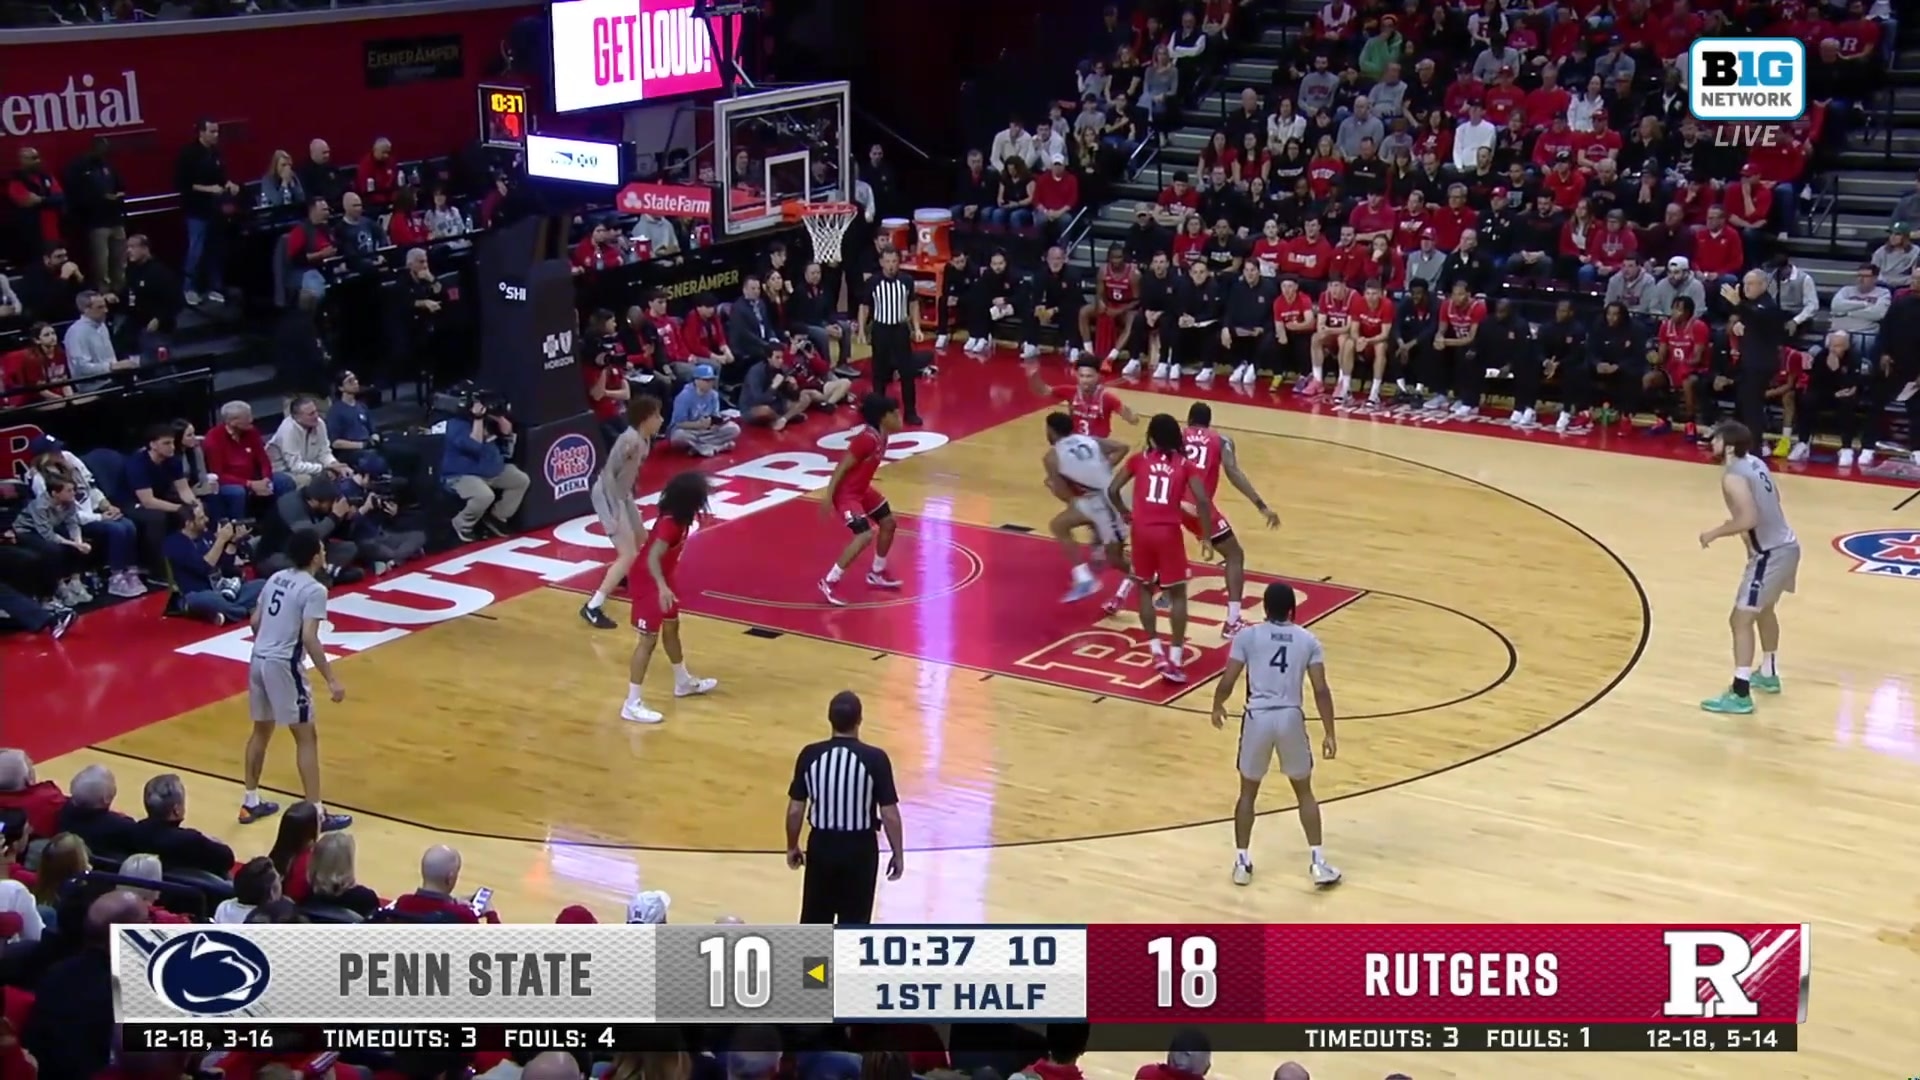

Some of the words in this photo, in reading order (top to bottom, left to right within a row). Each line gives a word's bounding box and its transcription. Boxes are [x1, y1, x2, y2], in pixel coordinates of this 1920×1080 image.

[593, 15, 637, 86] GET
[643, 7, 712, 80] LOUD!
[0, 70, 144, 137] ential
[491, 93, 523, 113] 10:37
[918, 227, 932, 243] G
[505, 286, 526, 301] SHI
[657, 269, 739, 299] SNERAMPER
[1079, 419, 1090, 435] 3
[557, 479, 586, 494] ARENA
[1145, 475, 1172, 504] 11
[1758, 471, 1773, 493] 3
[268, 589, 285, 617] 5
[1269, 646, 1289, 673] 4
